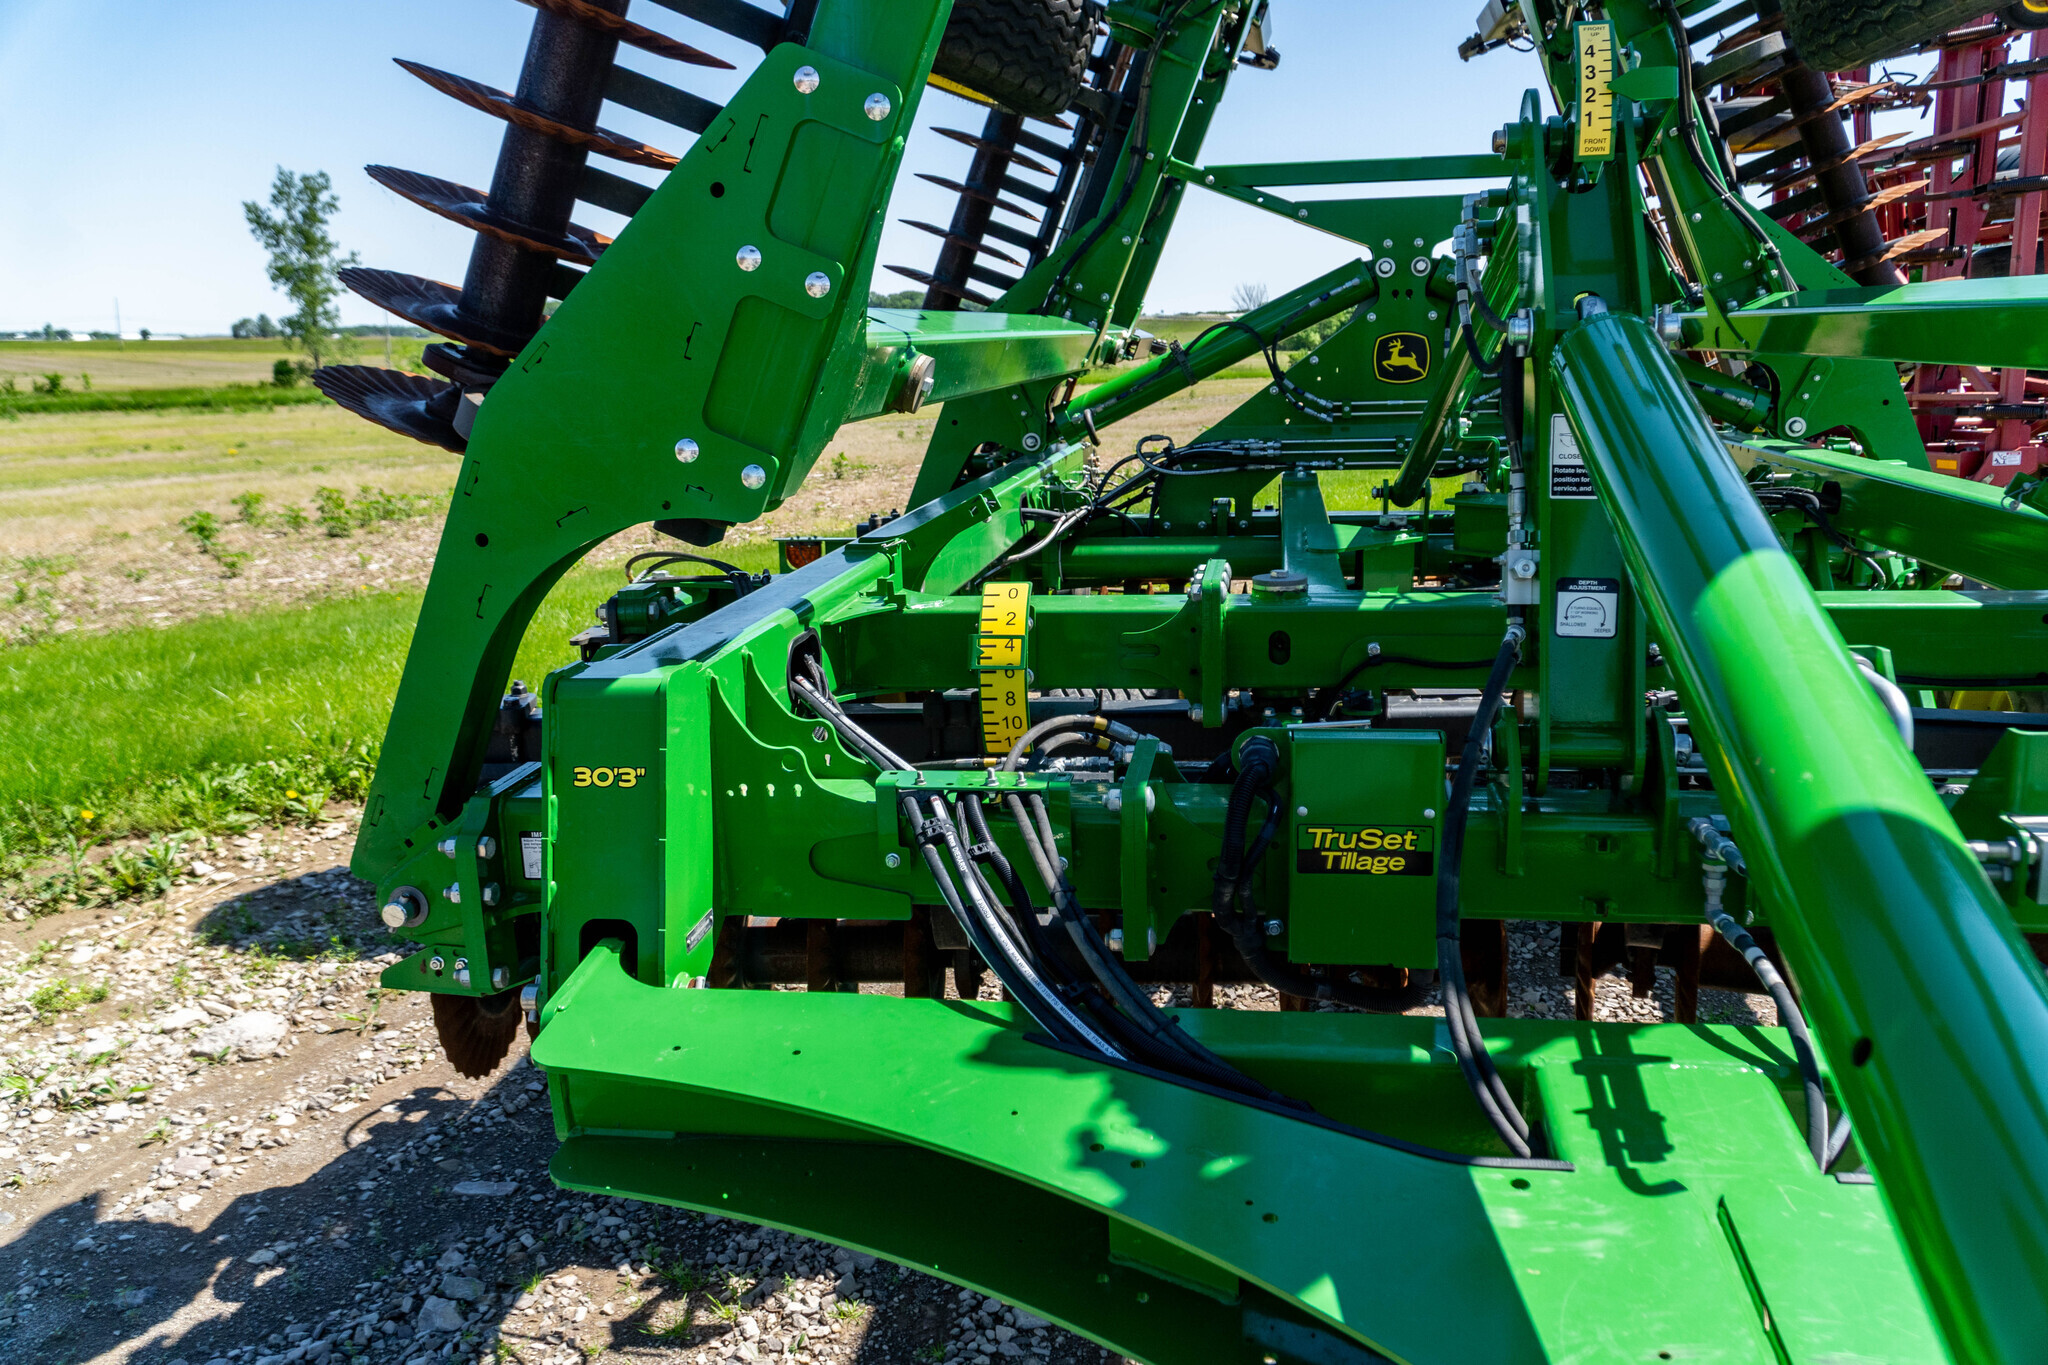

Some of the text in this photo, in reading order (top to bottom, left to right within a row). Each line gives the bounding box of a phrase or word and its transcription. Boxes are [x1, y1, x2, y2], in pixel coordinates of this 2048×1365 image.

[1584, 44, 1596, 58] 4
[1585, 65, 1596, 80] 3
[1585, 87, 1596, 103] 2
[1584, 111, 1592, 126] 1
[1008, 588, 1018, 599] 0
[1006, 612, 1016, 626] 2
[1004, 638, 1015, 652] 4
[1006, 691, 1016, 706] 8
[1002, 716, 1022, 730] 10
[573, 766, 646, 788] 30'3"
[1307, 828, 1418, 851] TruSet
[1321, 851, 1406, 874] Tillage
[1060, 1007, 1074, 1020] MSHA
